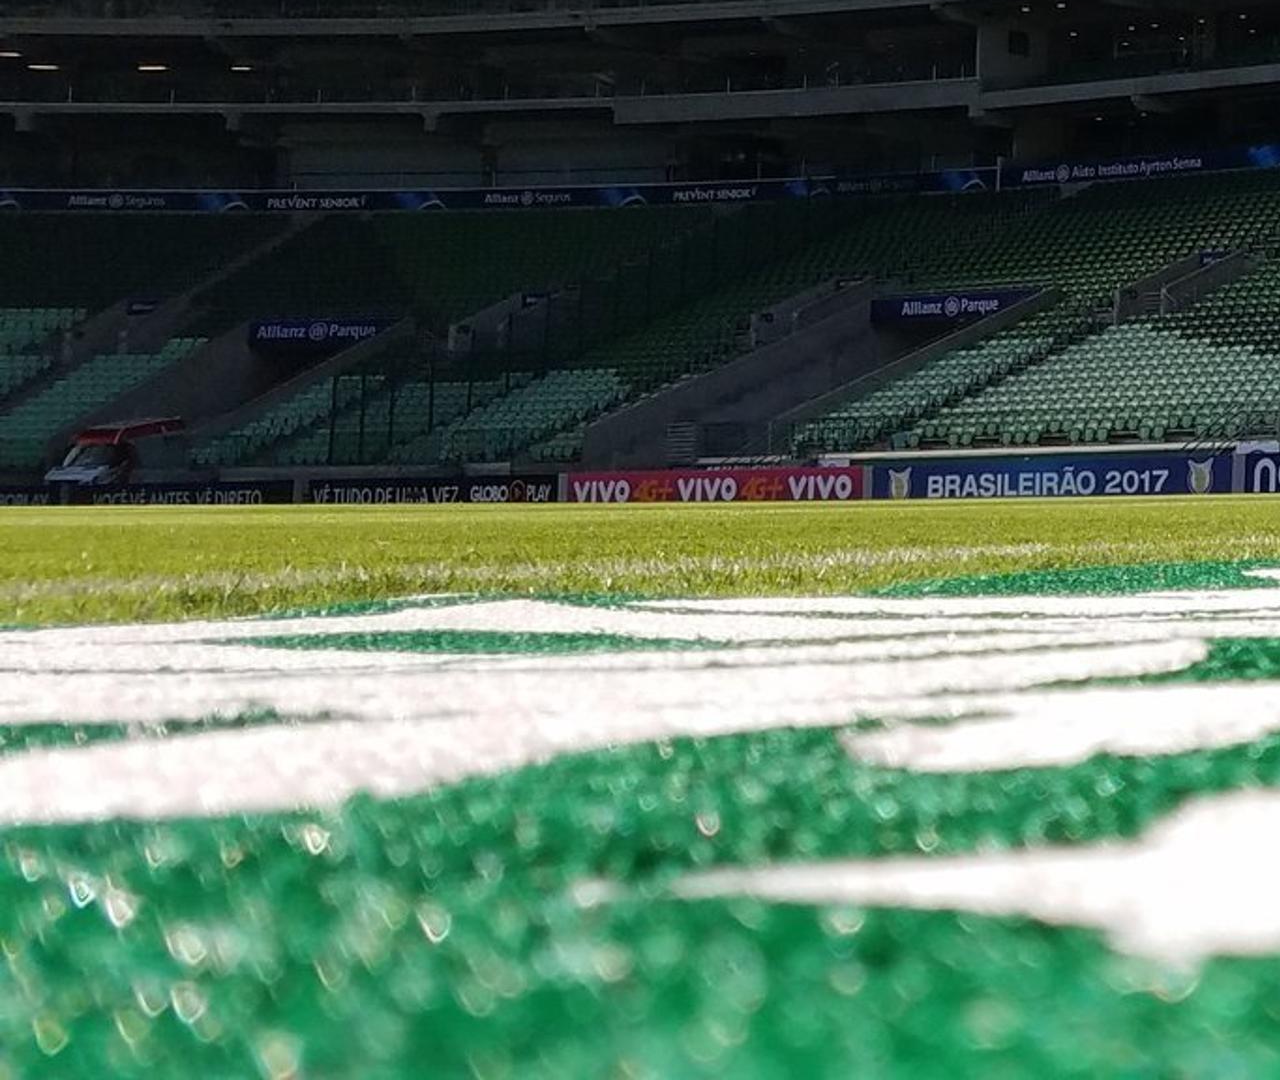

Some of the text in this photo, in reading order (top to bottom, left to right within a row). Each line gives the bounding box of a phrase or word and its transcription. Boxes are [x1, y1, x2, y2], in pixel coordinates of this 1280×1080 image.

[268, 195, 318, 209] PREVENT
[902, 297, 1000, 316] Allianz Parque
[257, 324, 378, 340] Allianz Parque
[928, 466, 1169, 498] BRASILEIRÃO 2017
[527, 483, 552, 502] PLAY
